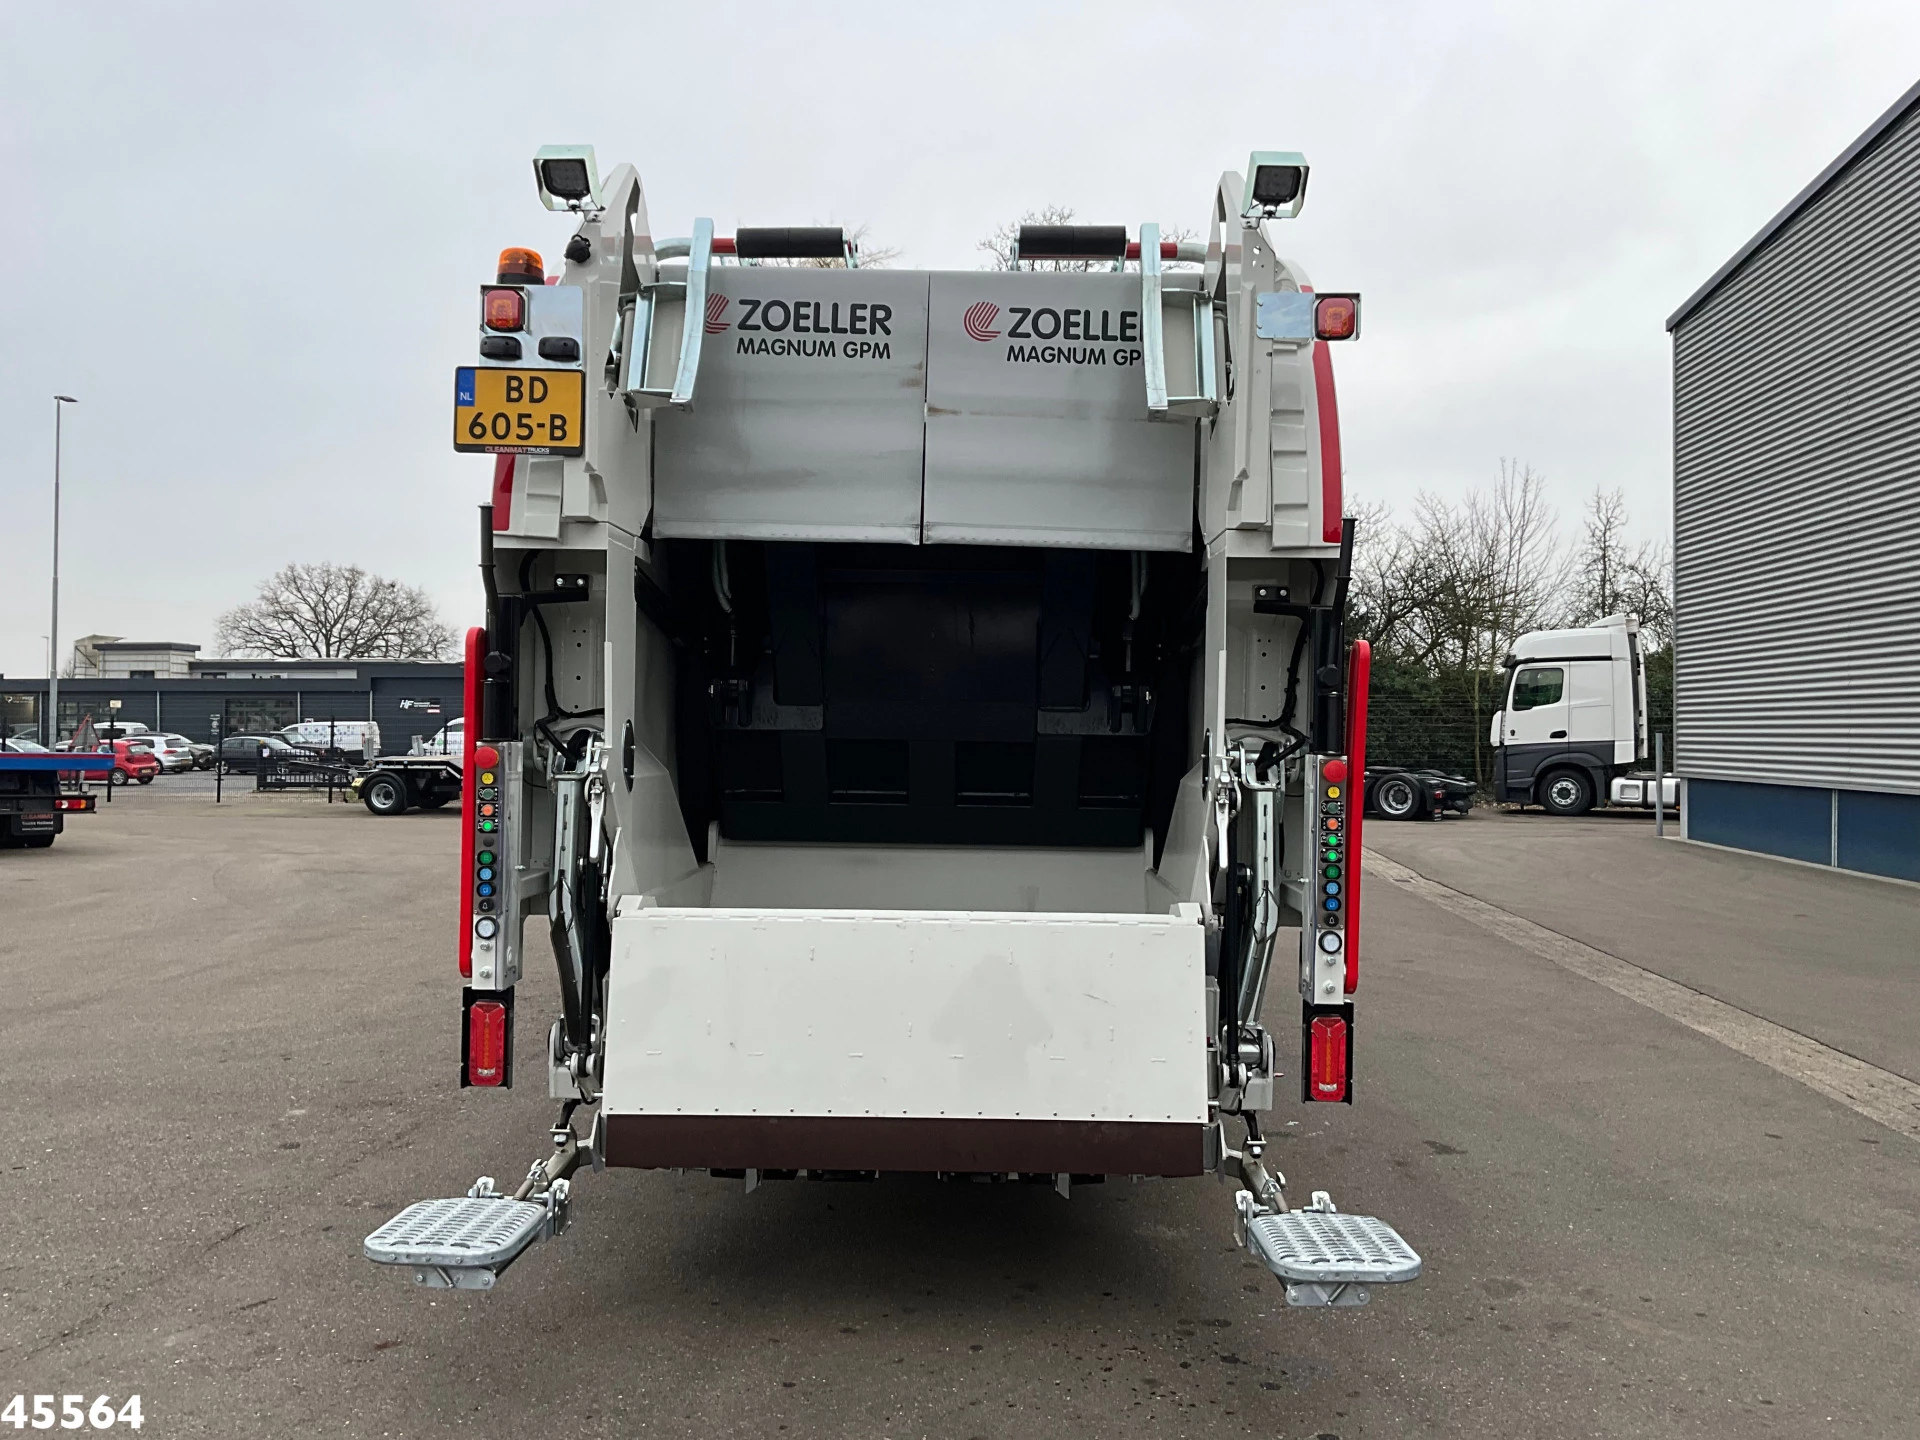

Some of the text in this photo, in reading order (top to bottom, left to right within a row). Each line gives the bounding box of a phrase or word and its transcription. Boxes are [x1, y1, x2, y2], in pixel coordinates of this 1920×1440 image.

[737, 299, 893, 336] ZOELLER
[1008, 307, 1143, 342] ZOELLE
[736, 337, 891, 360] MAGNUM GPM
[1007, 344, 1145, 367] MAGNUM GP
[459, 391, 473, 401] NL
[505, 375, 549, 404] BD
[468, 411, 568, 442] 605-B
